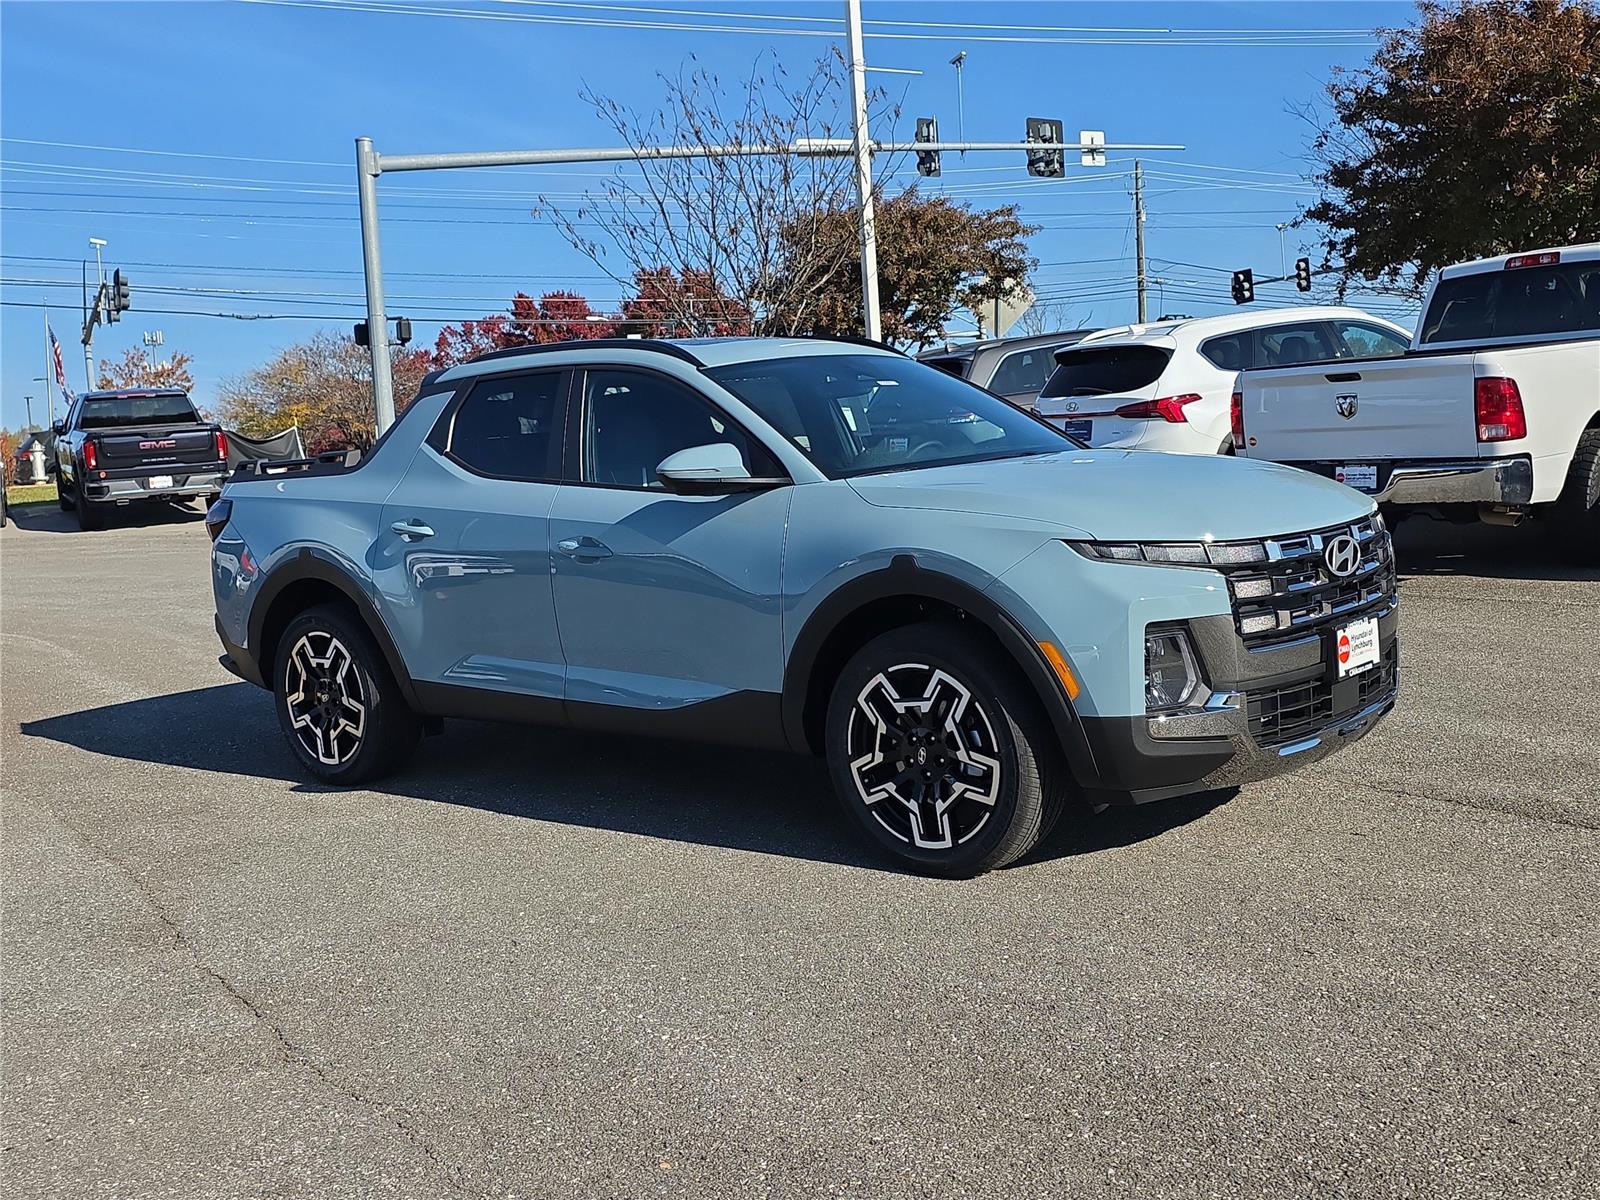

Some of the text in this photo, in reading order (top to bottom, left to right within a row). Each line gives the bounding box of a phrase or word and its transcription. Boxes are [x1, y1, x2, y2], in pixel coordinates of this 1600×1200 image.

[139, 440, 176, 449] GMC
[1351, 630, 1368, 643] Hyundai
[1351, 639, 1373, 653] Lynchburg
